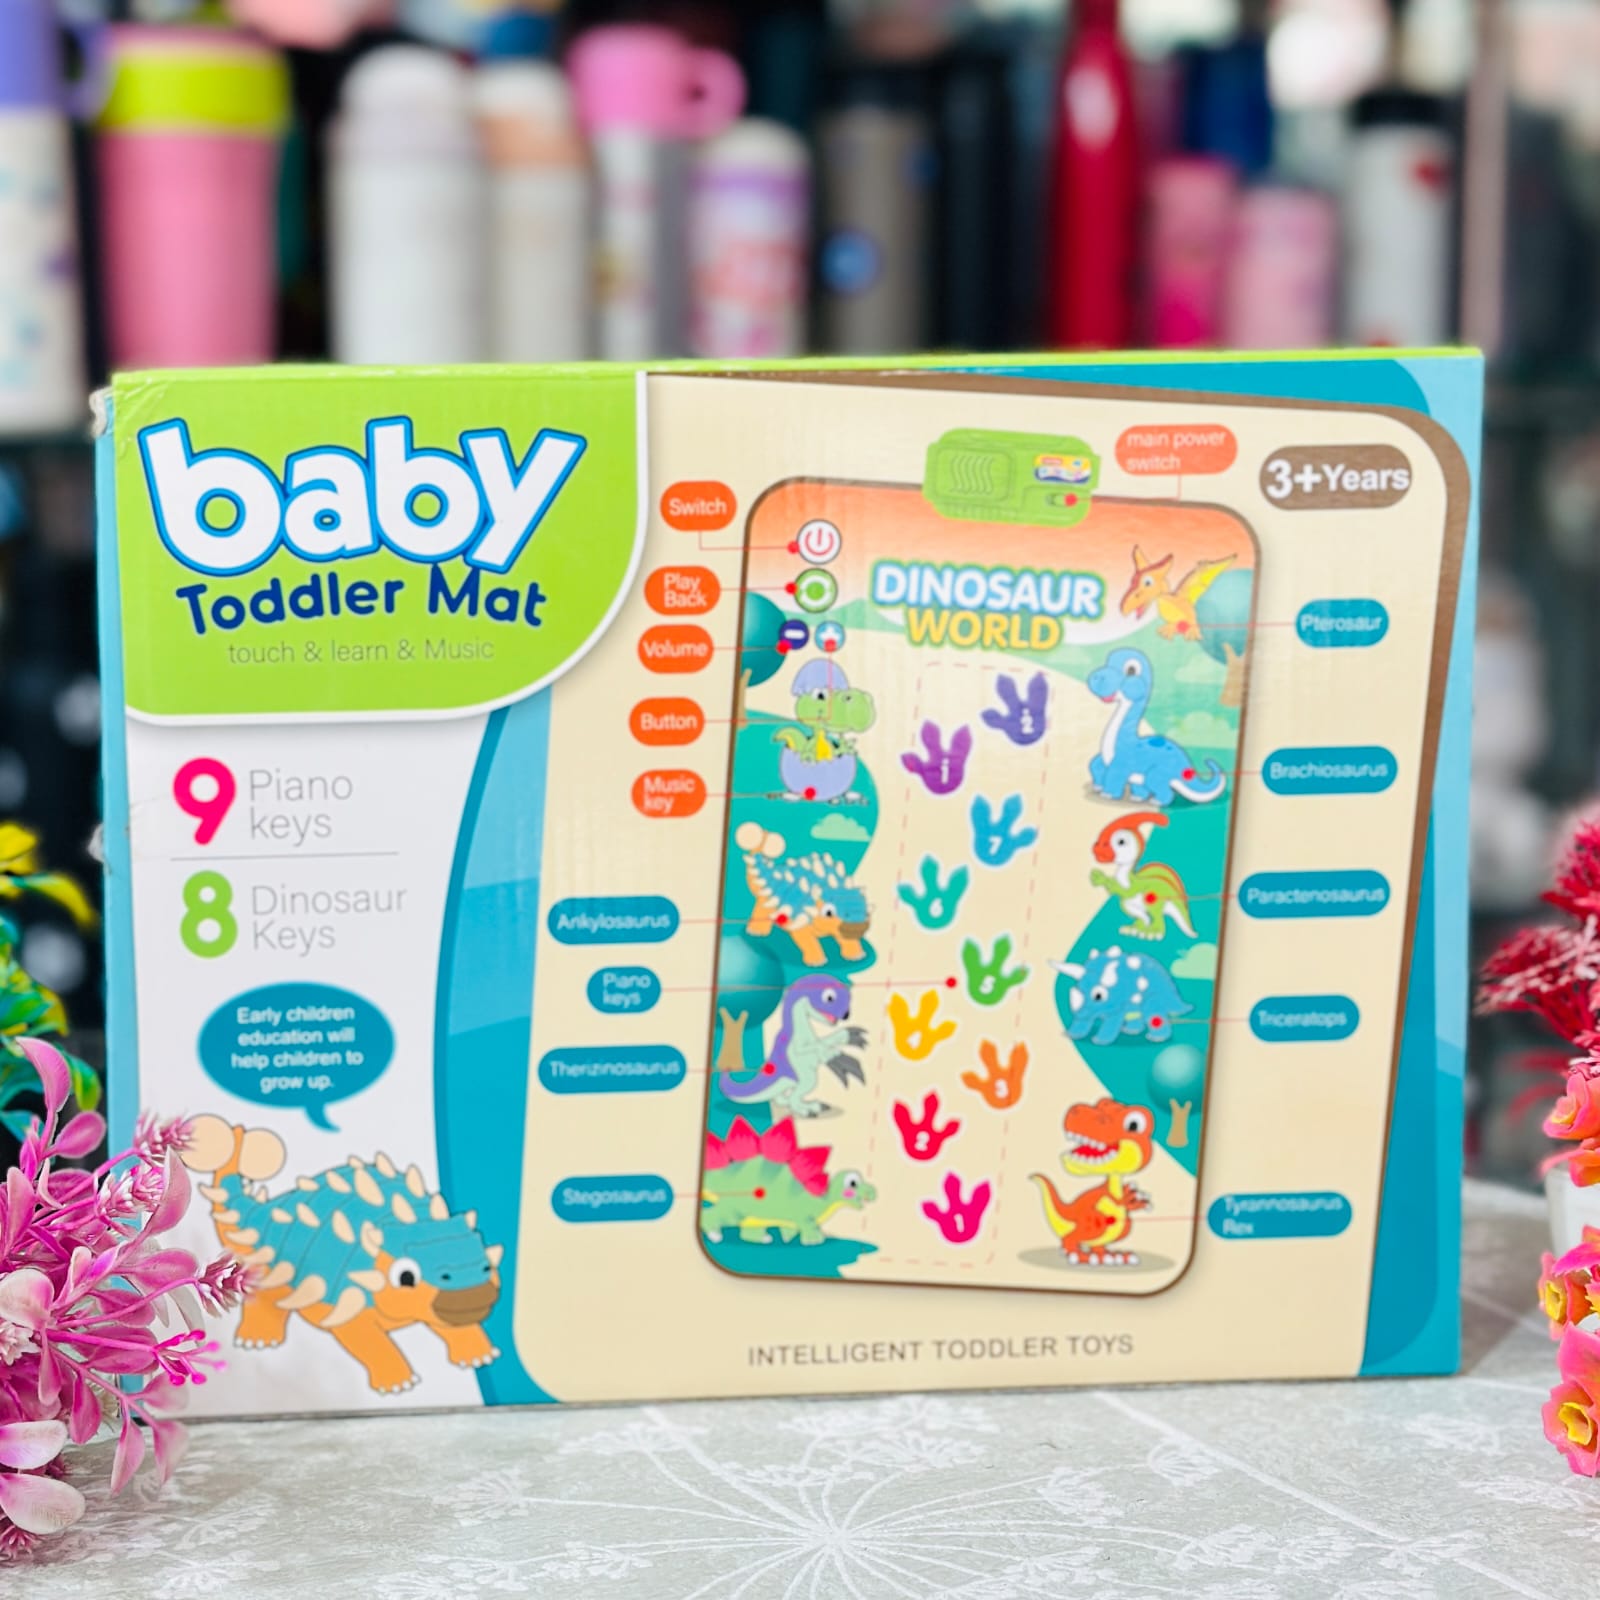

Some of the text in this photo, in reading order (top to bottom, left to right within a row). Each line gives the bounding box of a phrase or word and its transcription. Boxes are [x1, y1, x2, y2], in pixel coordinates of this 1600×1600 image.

[1126, 429, 1226, 448] main power
[1125, 453, 1181, 471] switch
[137, 415, 588, 577] baby
[668, 499, 727, 516] Switch
[663, 573, 702, 592] Play
[873, 563, 1106, 619] DINOSAUR
[176, 561, 547, 635] Toddler Mat
[663, 591, 707, 609] Back
[905, 606, 1062, 652] WORLD
[1300, 613, 1383, 632] Pterosaur
[228, 637, 495, 663] touch & learn & Music
[643, 640, 708, 658] Volume
[640, 713, 698, 731] Button
[1269, 760, 1389, 779] Brachiosaurus
[249, 769, 354, 802] Piano
[643, 776, 695, 795] Music
[173, 757, 237, 846] 9
[643, 794, 675, 813] key
[250, 808, 333, 848] keys
[988, 836, 1002, 856] 7
[251, 884, 408, 916] Dinosaur
[929, 898, 943, 918] 6
[180, 870, 239, 958] 8
[252, 920, 336, 957] Keys
[602, 972, 651, 989] Piano
[602, 989, 641, 1008] keys
[237, 1006, 355, 1026] Early children
[238, 1028, 355, 1048] education will
[231, 1049, 364, 1071] help children to
[260, 1073, 335, 1094] grow up.
[914, 1131, 930, 1152] 2
[748, 1334, 1133, 1367] INTELLIGENT TODDLER TOYS
